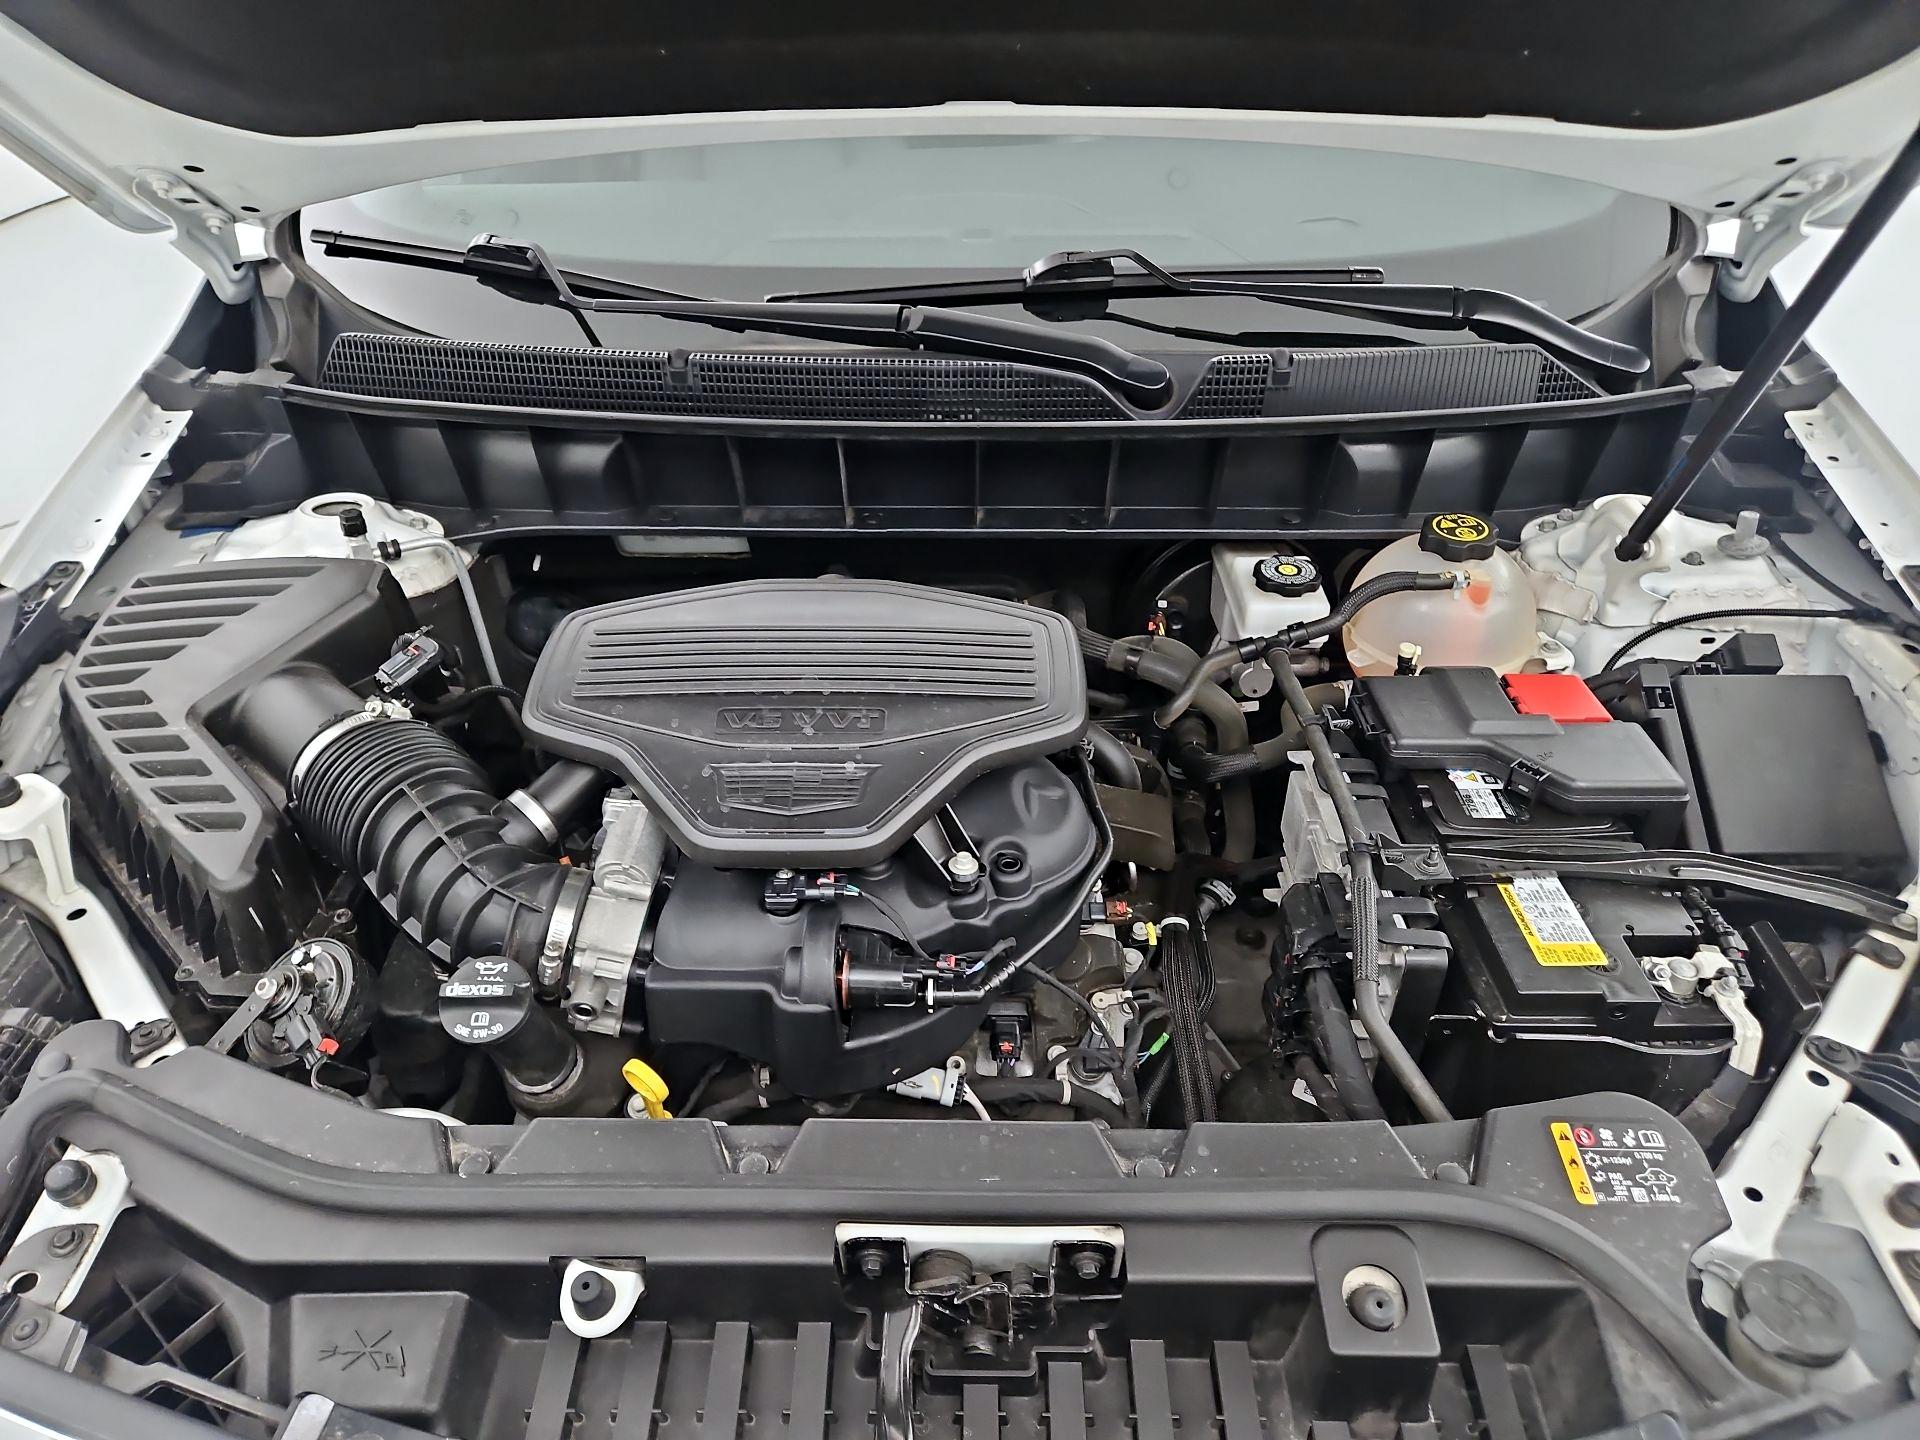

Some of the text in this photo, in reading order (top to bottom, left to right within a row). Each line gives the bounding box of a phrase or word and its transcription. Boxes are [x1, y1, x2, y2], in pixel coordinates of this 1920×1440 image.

[724, 711, 880, 729] V6 VVT
[1501, 886, 1531, 934] DANGER POISON
[445, 982, 505, 996] dexos
[454, 1022, 504, 1039] SAE 5W-30
[1602, 1157, 1632, 1166] R-1234yf
[1633, 1152, 1664, 1161] 0.700 kg
[1607, 1172, 1624, 1181] PAG
[1670, 1195, 1681, 1203] kg
